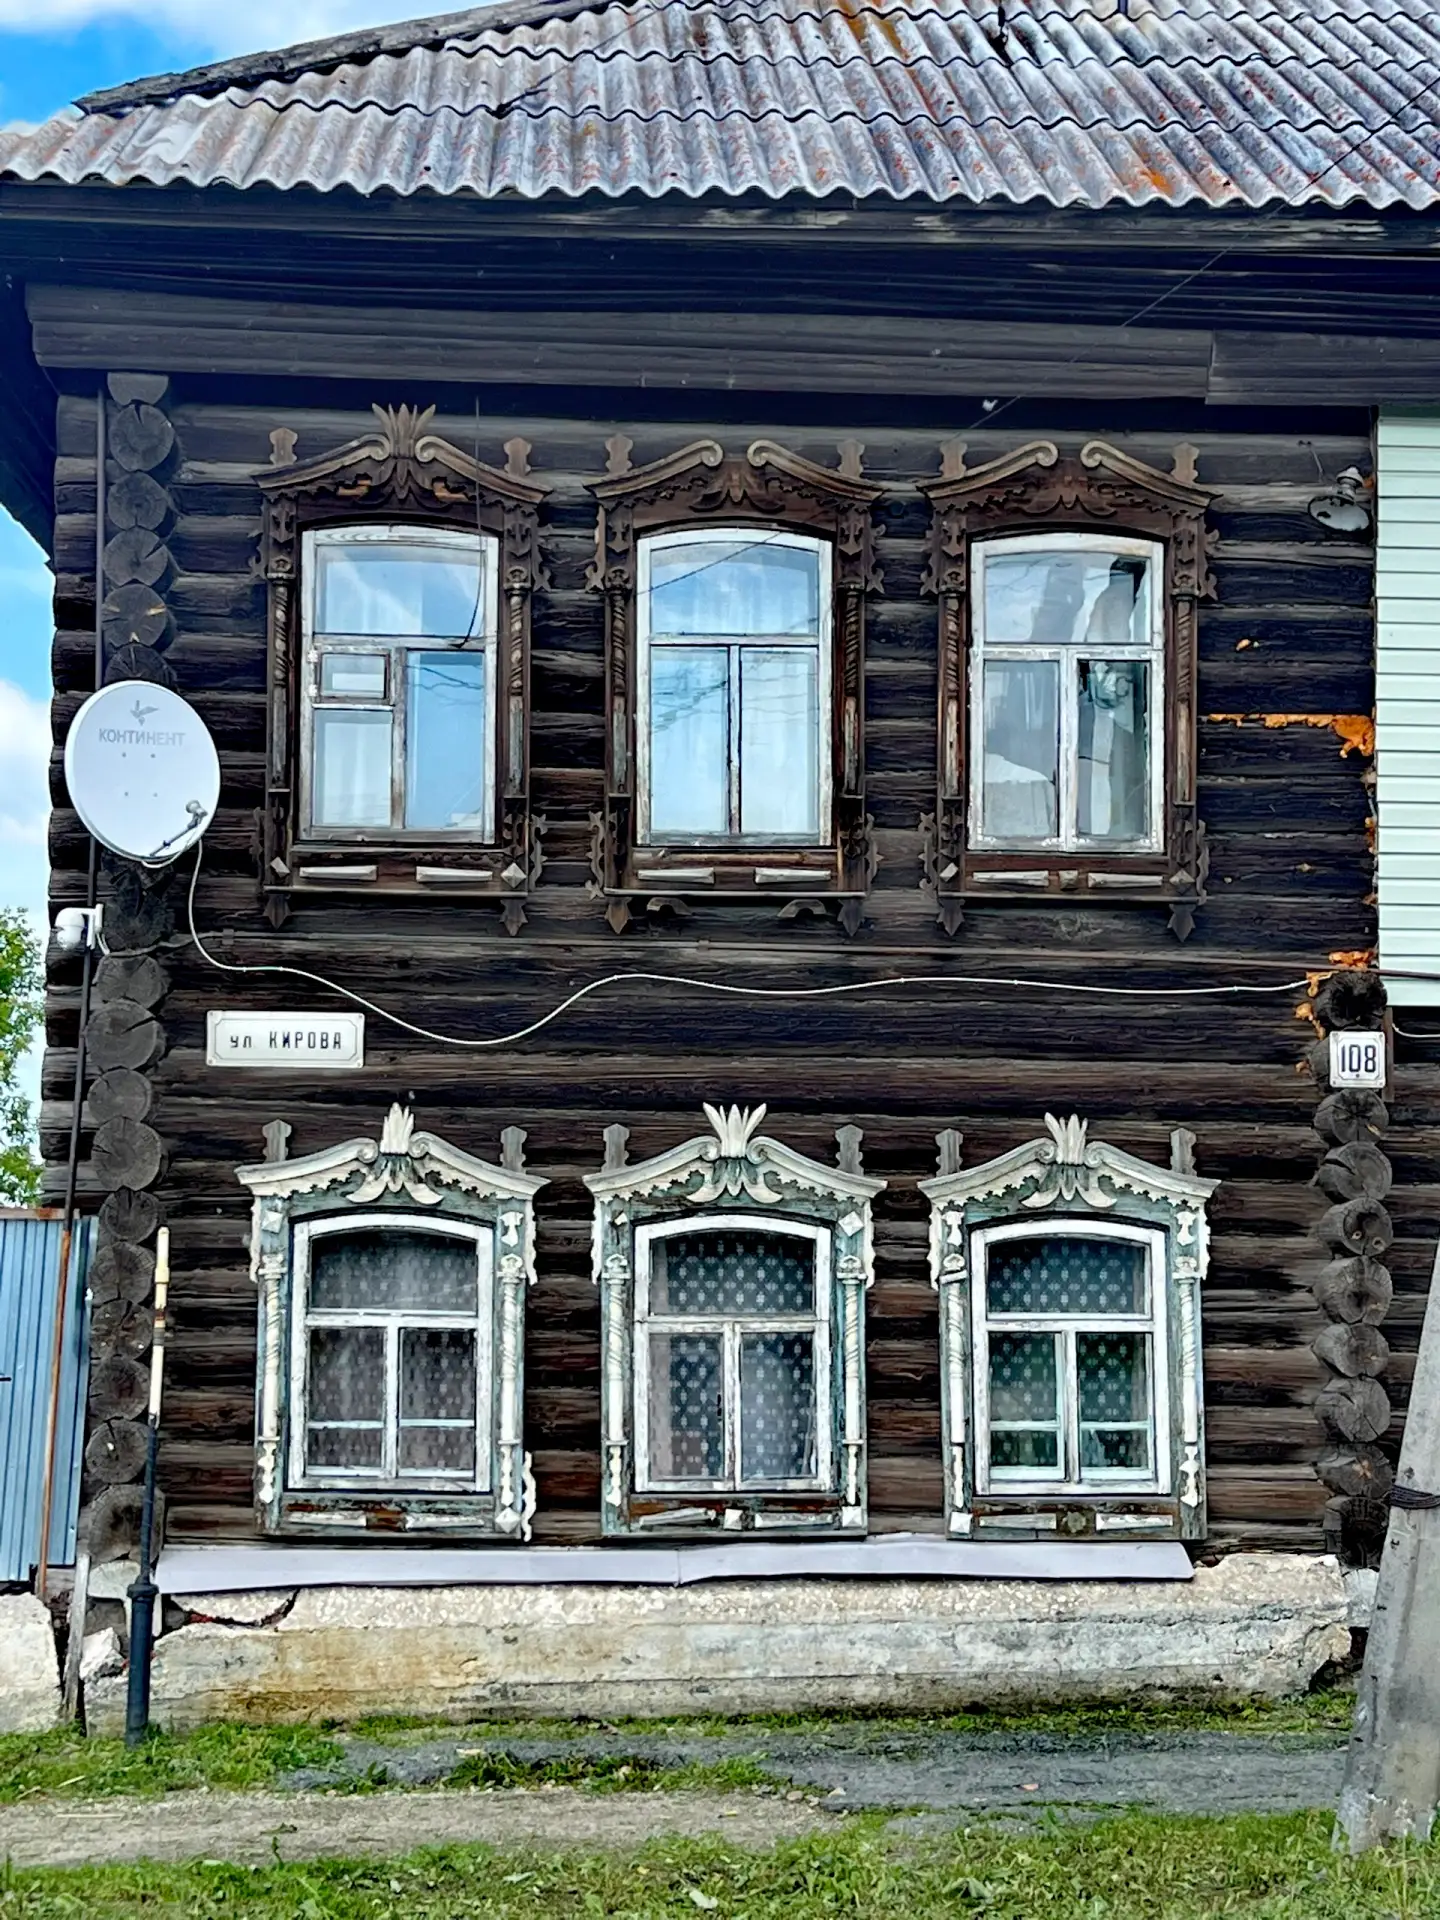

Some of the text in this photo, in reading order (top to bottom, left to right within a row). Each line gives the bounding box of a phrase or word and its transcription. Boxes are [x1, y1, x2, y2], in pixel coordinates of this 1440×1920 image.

[98, 728, 186, 746] КОНТИНЕНТ
[269, 1030, 342, 1050] КИРОВА
[1341, 1044, 1377, 1073] 108
